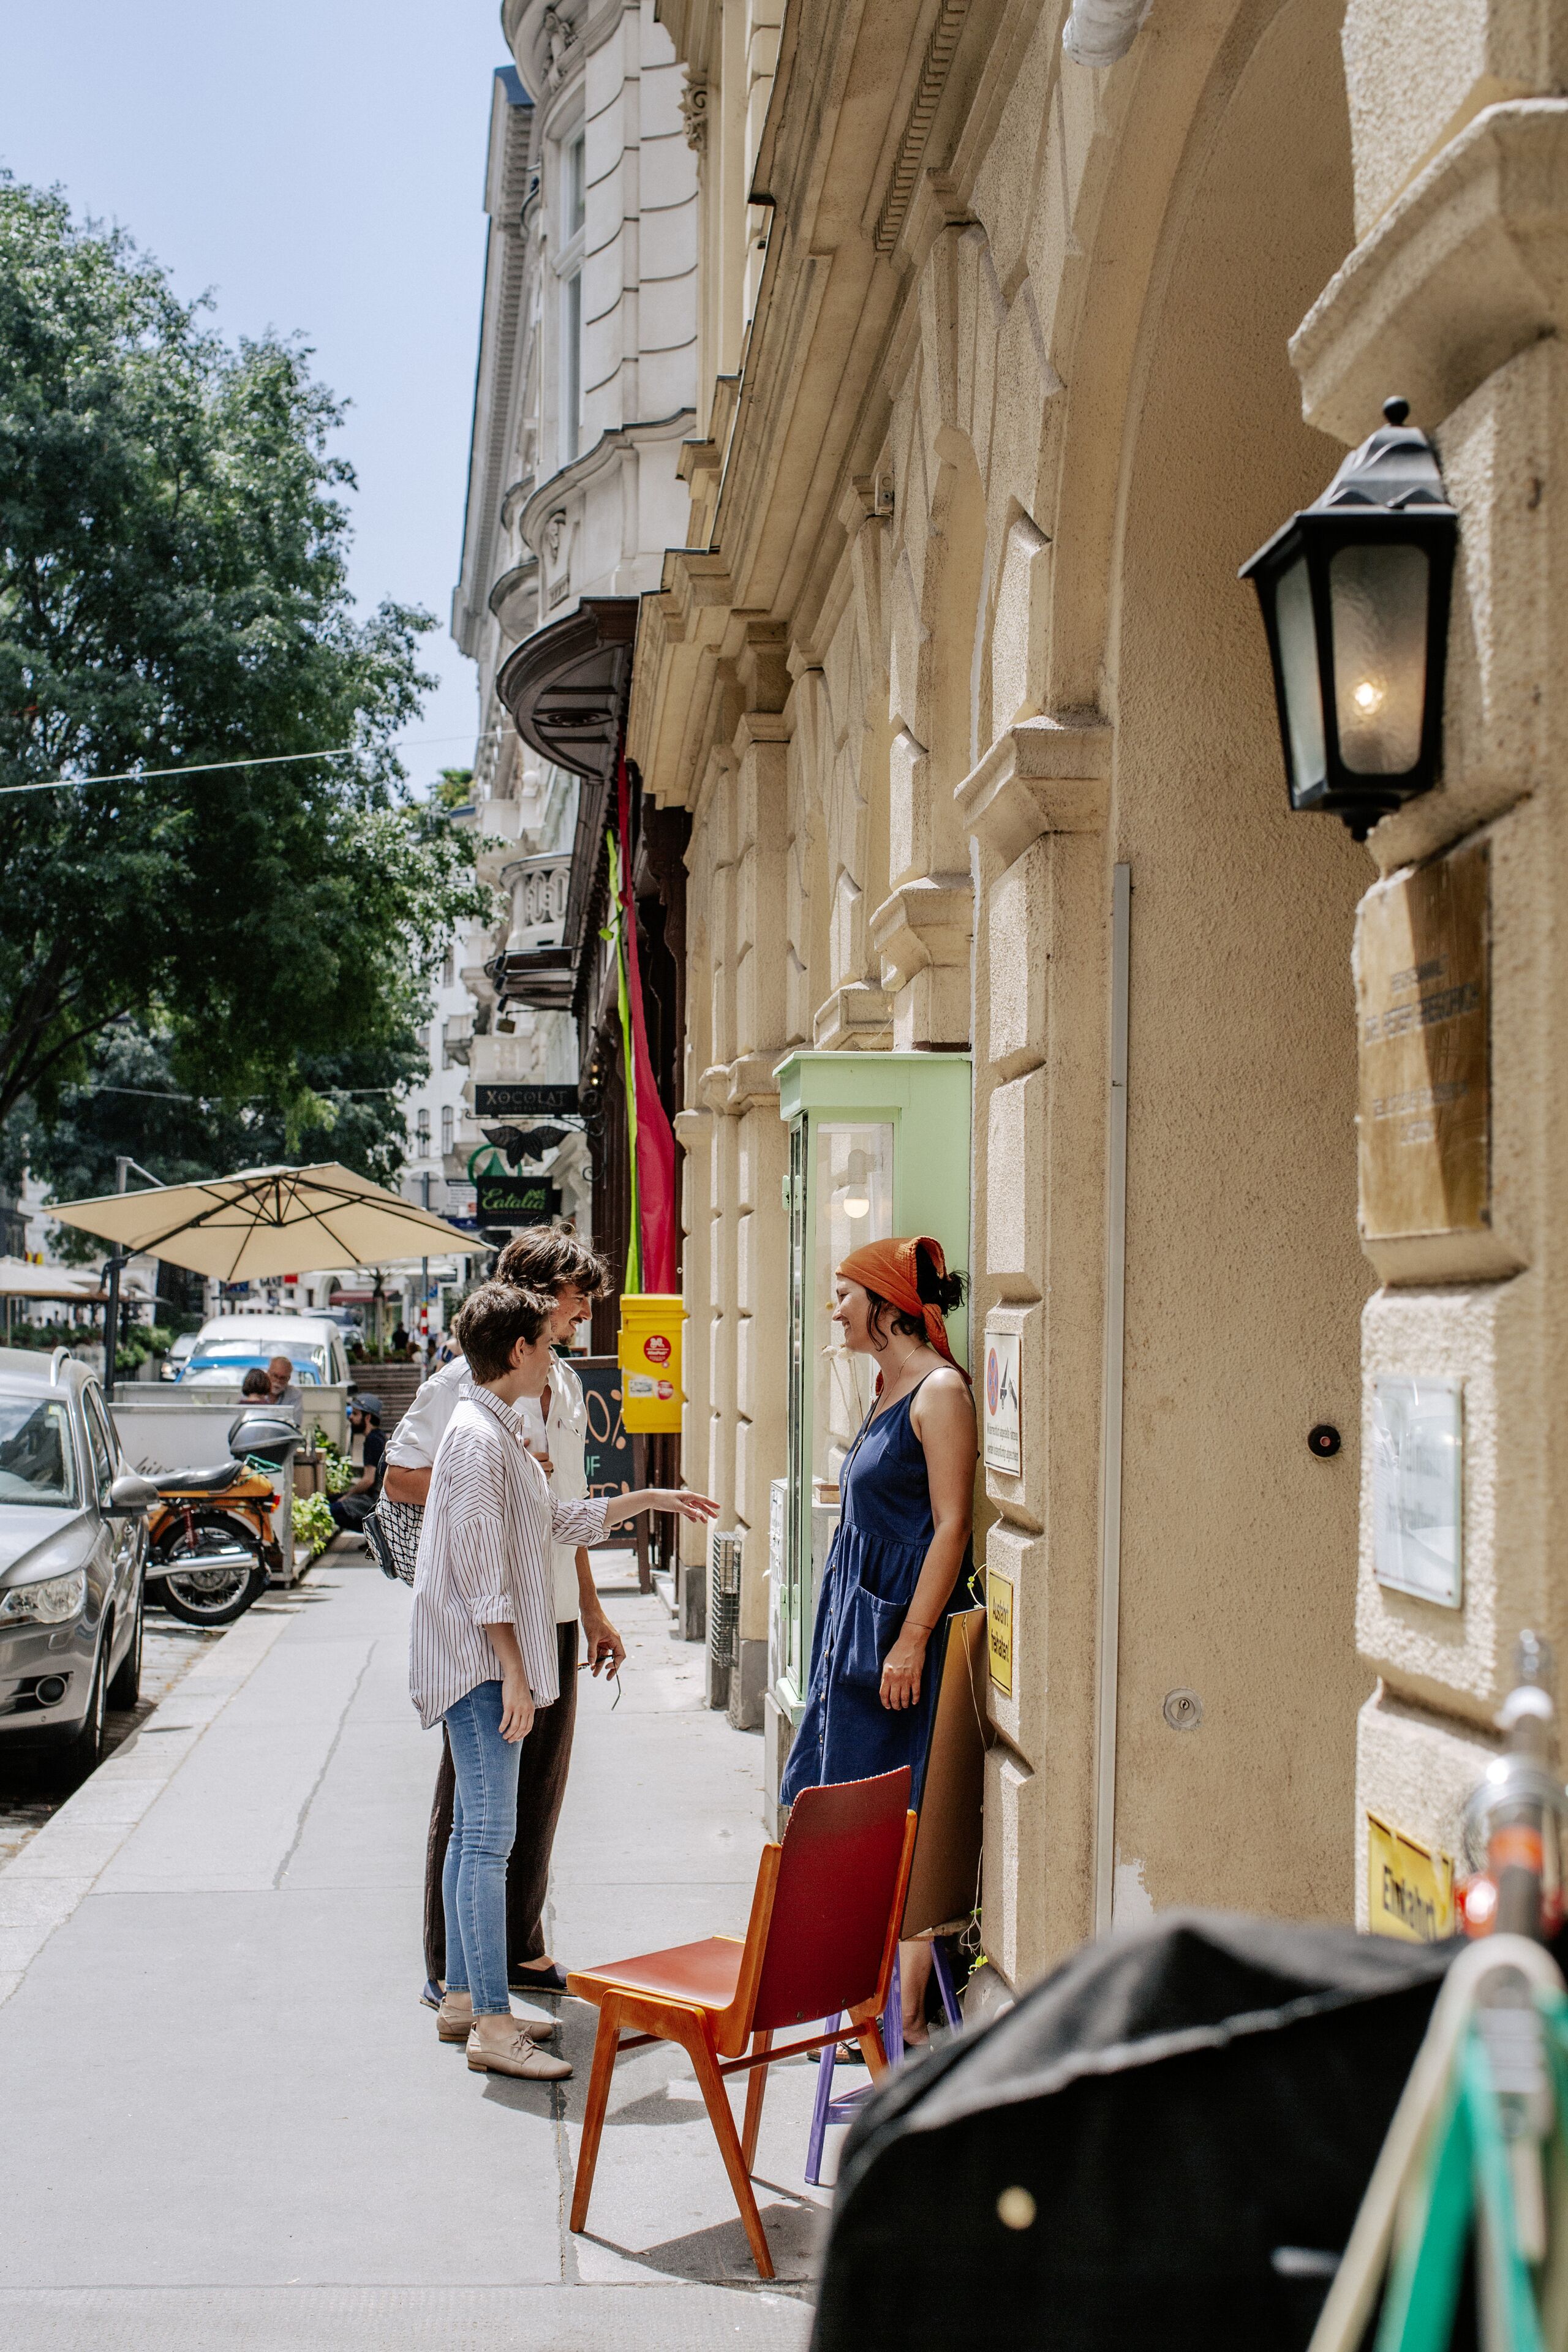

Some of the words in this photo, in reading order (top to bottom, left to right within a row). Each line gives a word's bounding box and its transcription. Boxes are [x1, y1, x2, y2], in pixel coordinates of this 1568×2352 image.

[486, 1090, 567, 1107] XOCOLAT
[992, 1596, 1009, 1627] Ausfahrt
[991, 1628, 1009, 1664] freihalten!
